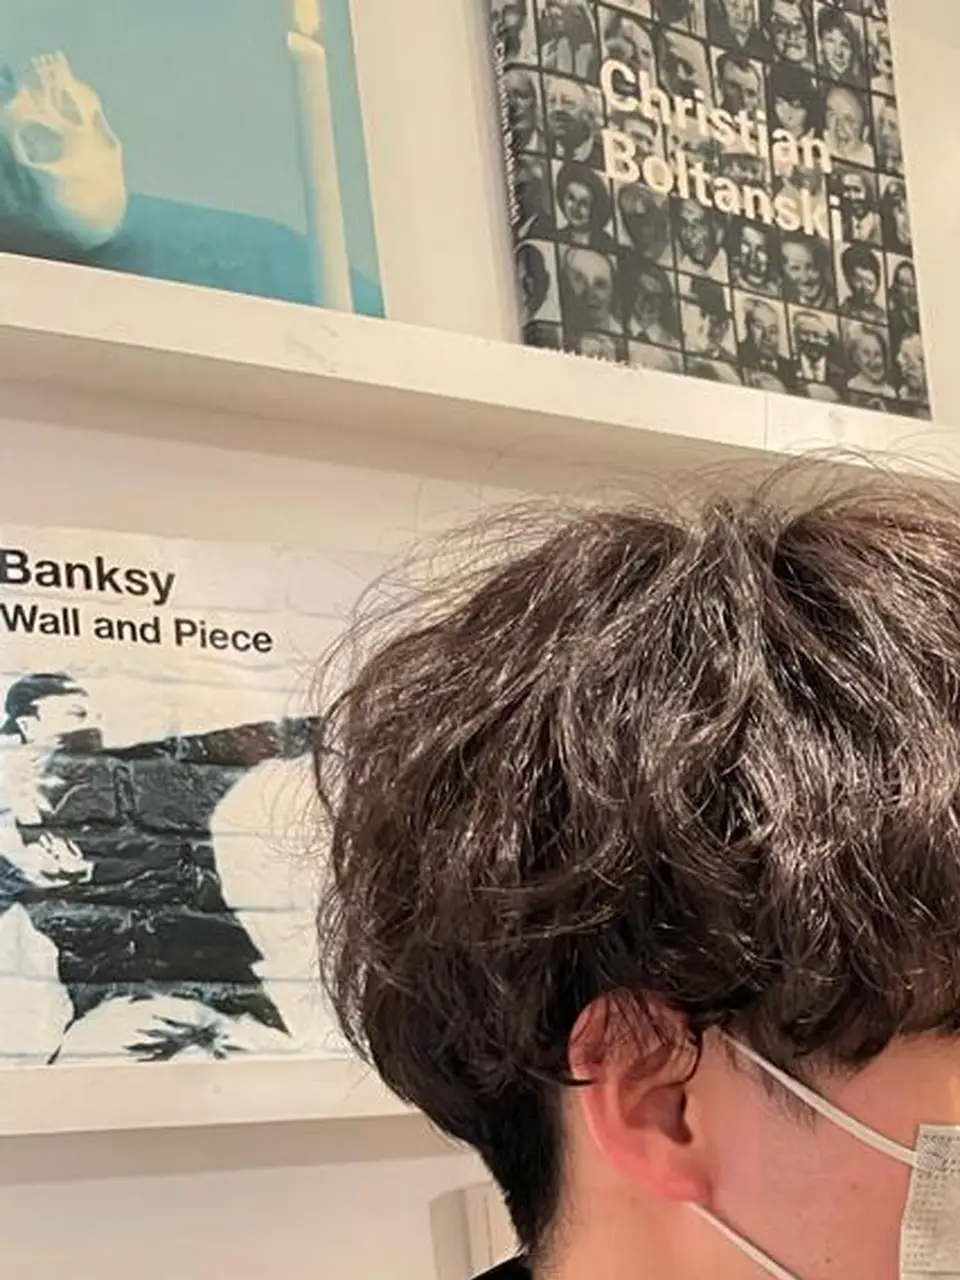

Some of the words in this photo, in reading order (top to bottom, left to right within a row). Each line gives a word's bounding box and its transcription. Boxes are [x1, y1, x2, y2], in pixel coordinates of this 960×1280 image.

[601, 59, 832, 174] Christian
[602, 129, 843, 241] Boltanski
[0, 549, 176, 606] Banksy
[1, 604, 79, 637] Wall
[94, 616, 162, 646] and
[174, 618, 273, 653] Piece
